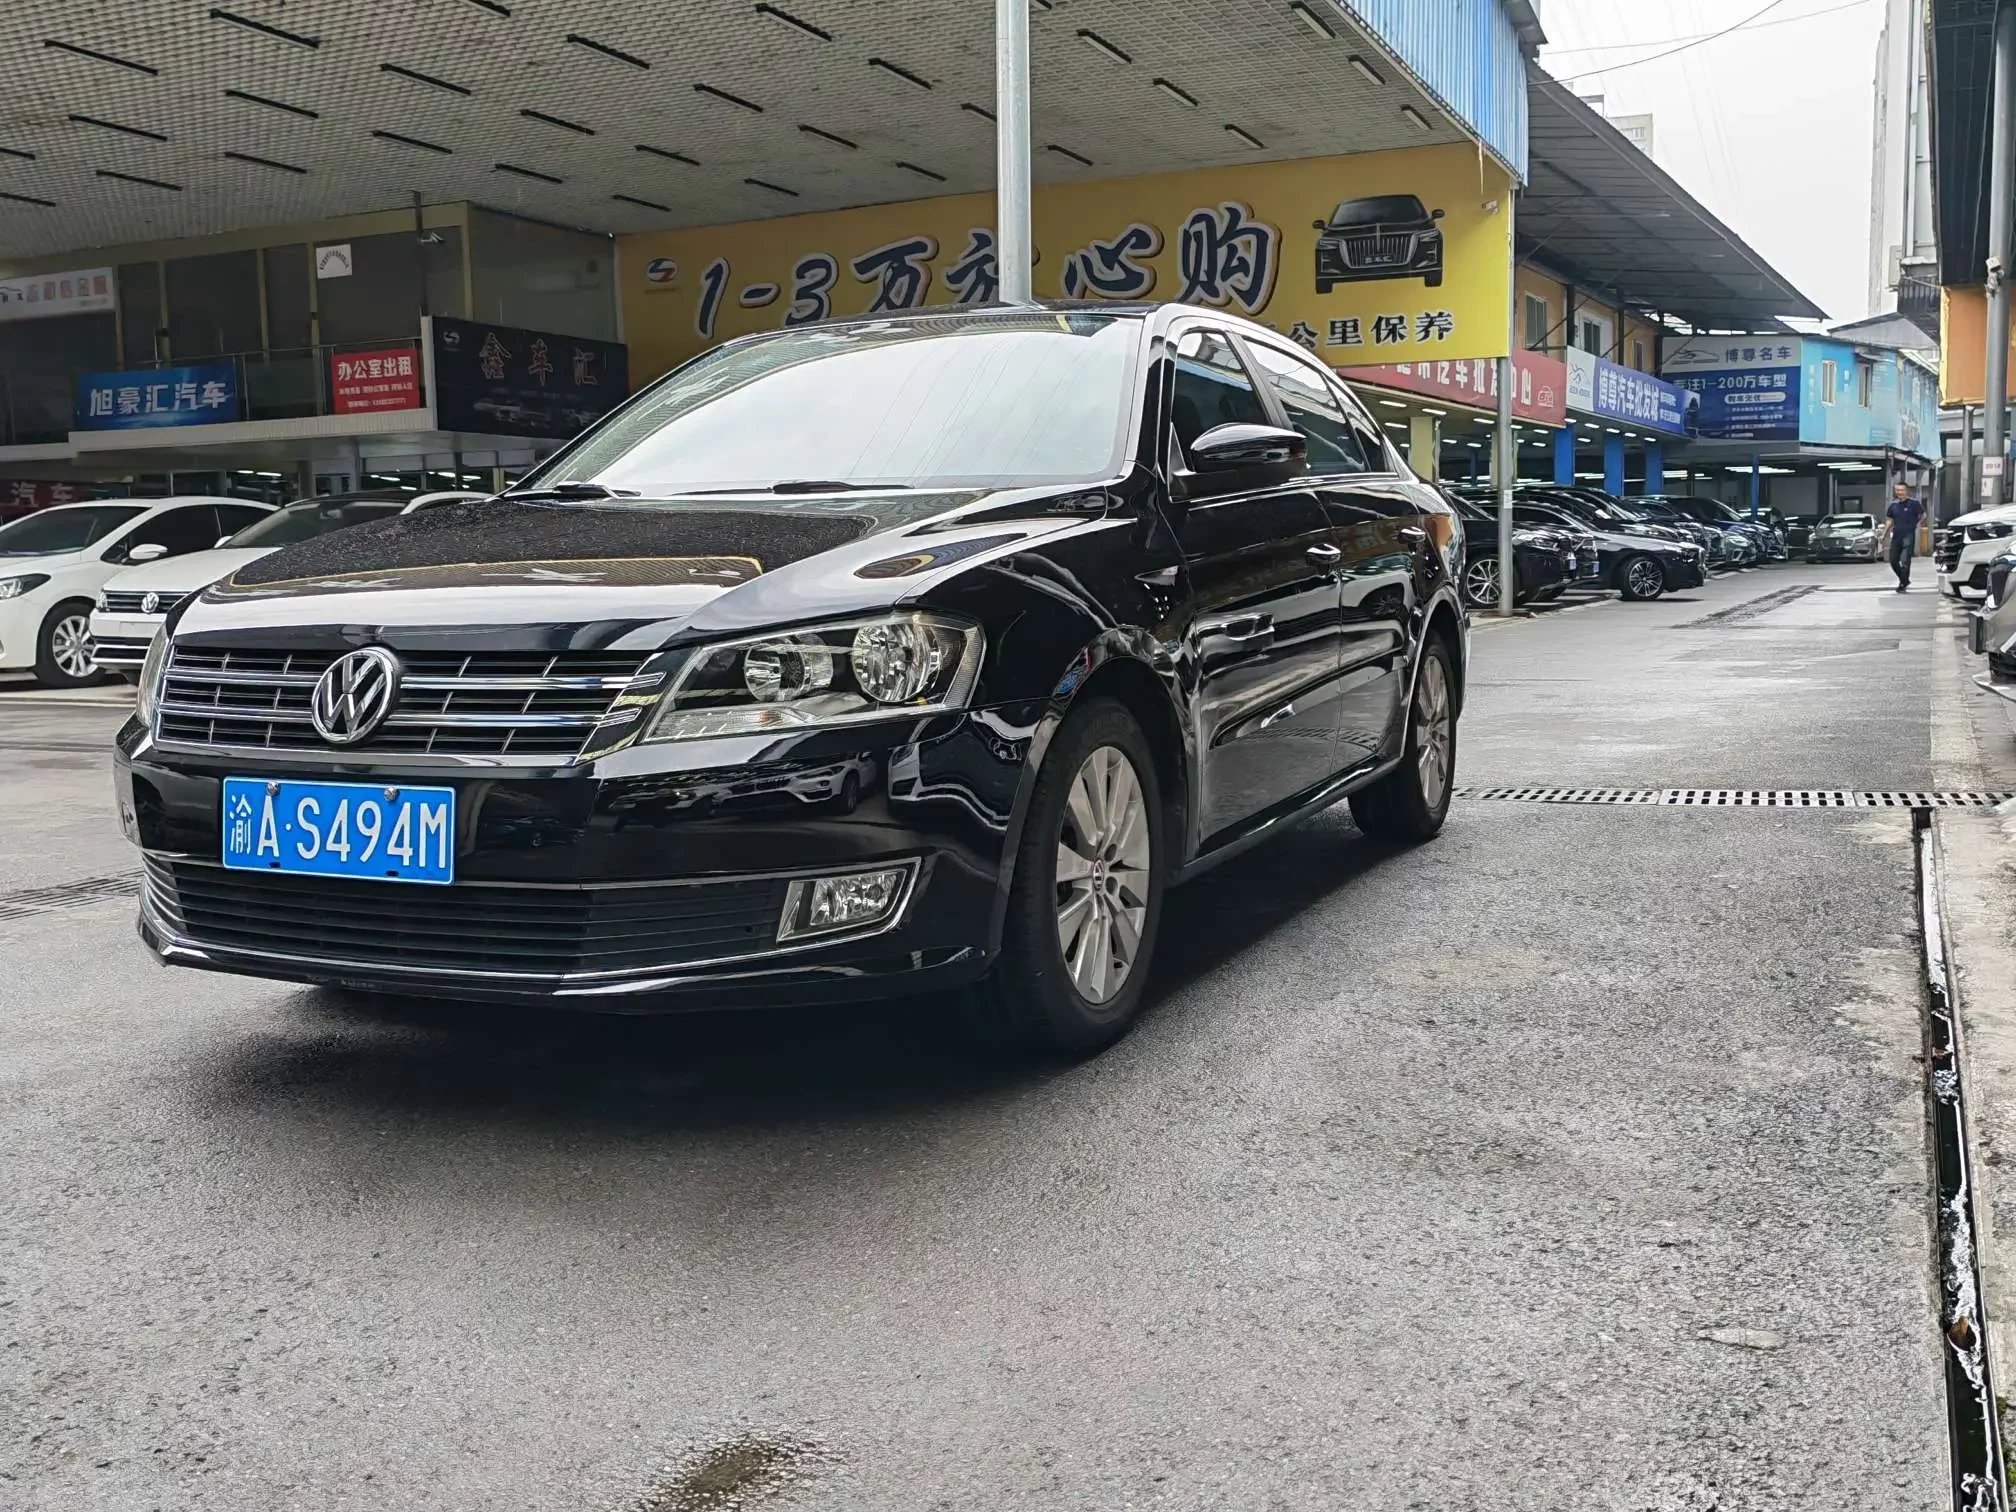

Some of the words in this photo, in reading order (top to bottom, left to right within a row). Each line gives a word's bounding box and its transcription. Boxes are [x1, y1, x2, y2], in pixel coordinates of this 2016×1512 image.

[1265, 311, 1455, 350] 公里保养
[337, 356, 413, 381] 办公室出租
[1726, 346, 1791, 363] 博尊名车
[89, 381, 226, 416] 旭豪汇汽车
[11, 482, 74, 508] 汽车
[230, 794, 448, 869] 渝A·S494M
